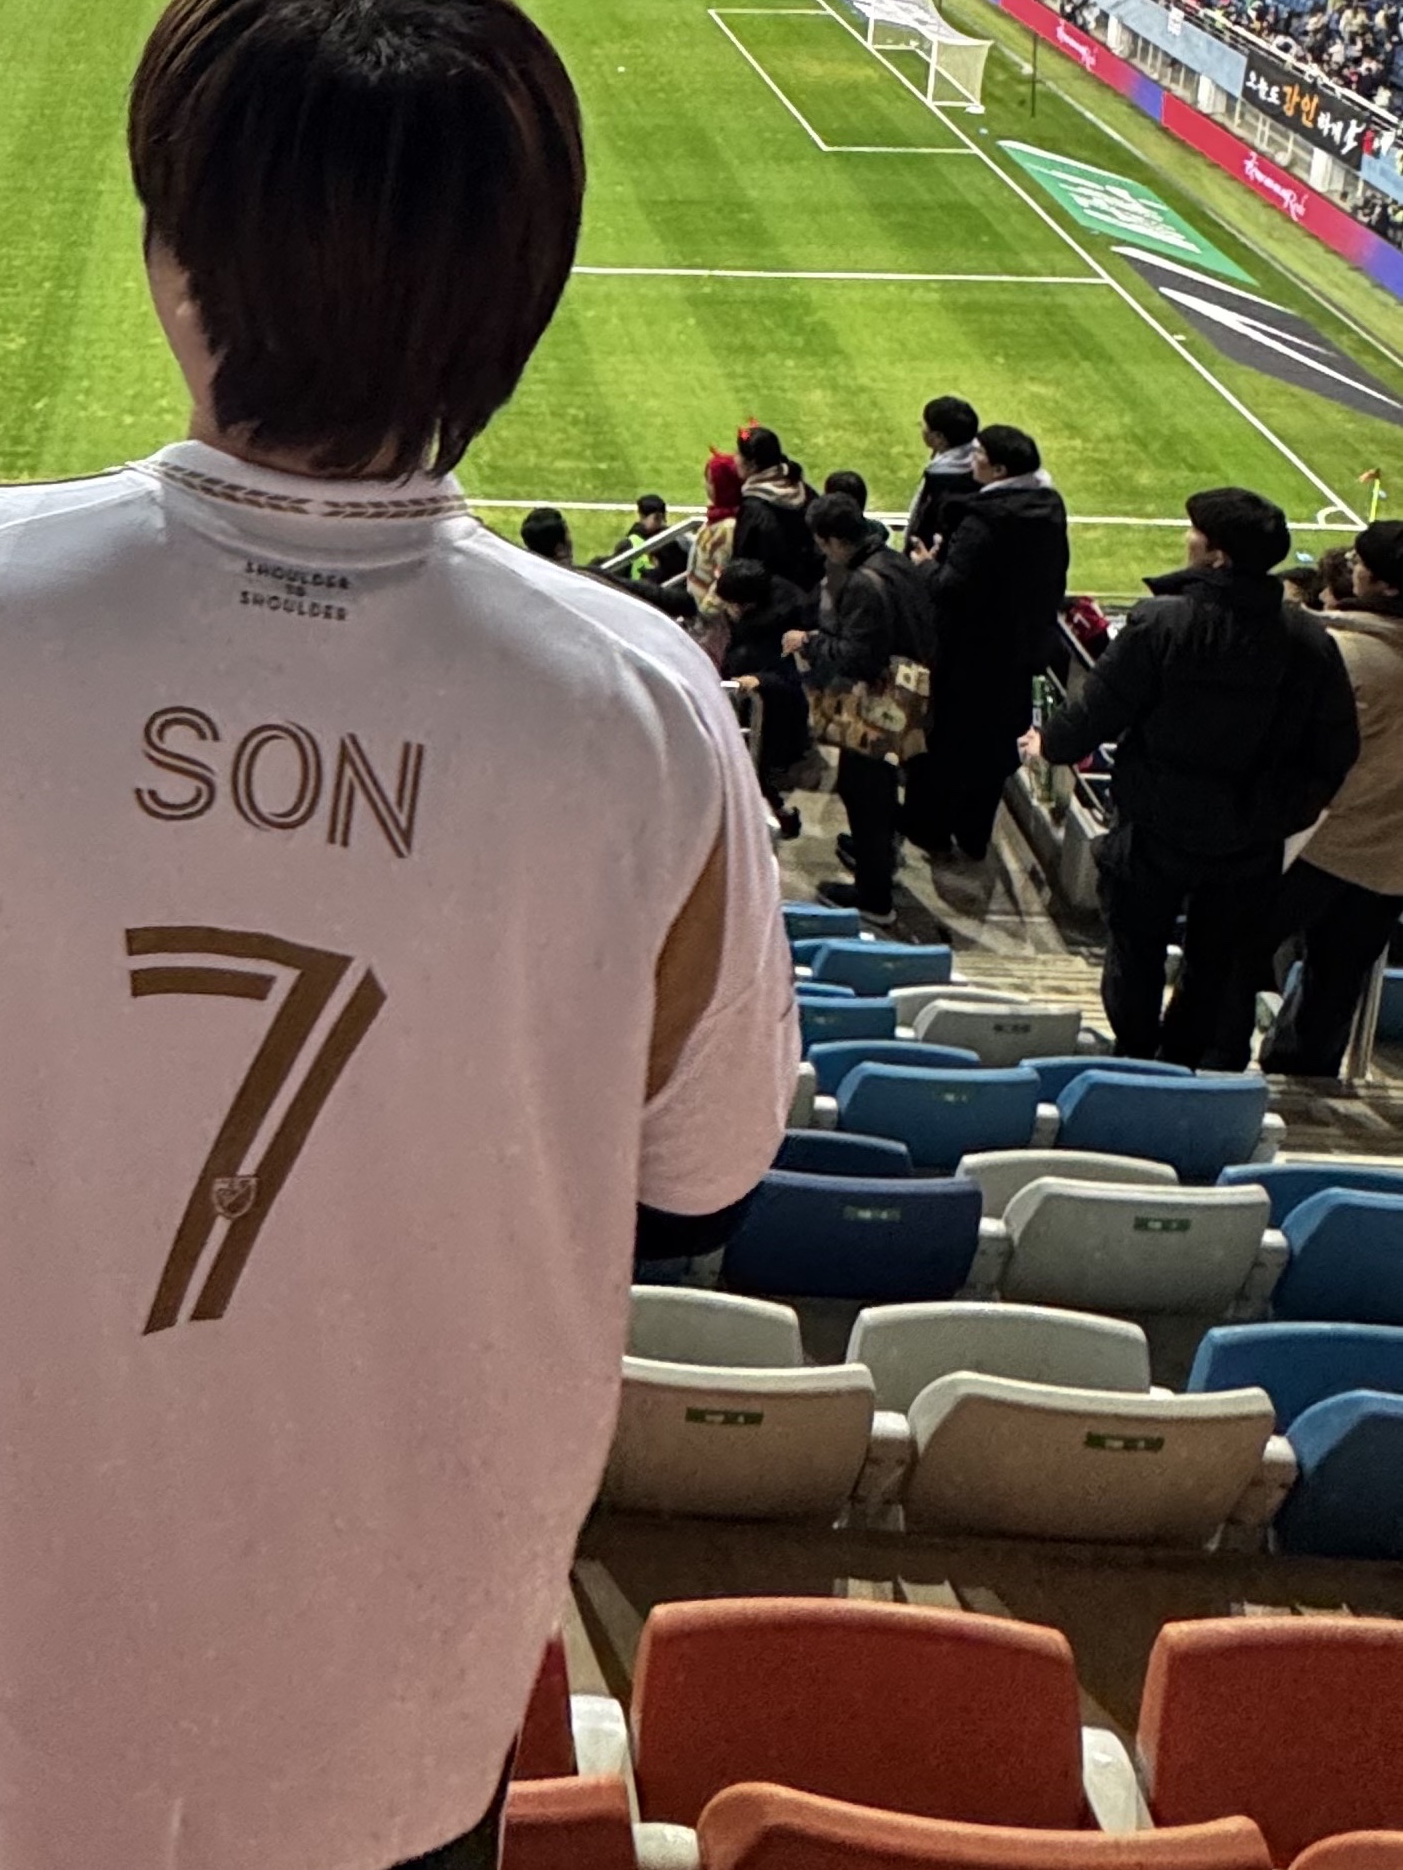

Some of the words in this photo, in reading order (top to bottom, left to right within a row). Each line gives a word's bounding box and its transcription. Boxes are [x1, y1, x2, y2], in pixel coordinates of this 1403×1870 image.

[240, 591, 347, 621] SHOULDER
[135, 705, 425, 859] SON
[124, 925, 388, 1336] 7
